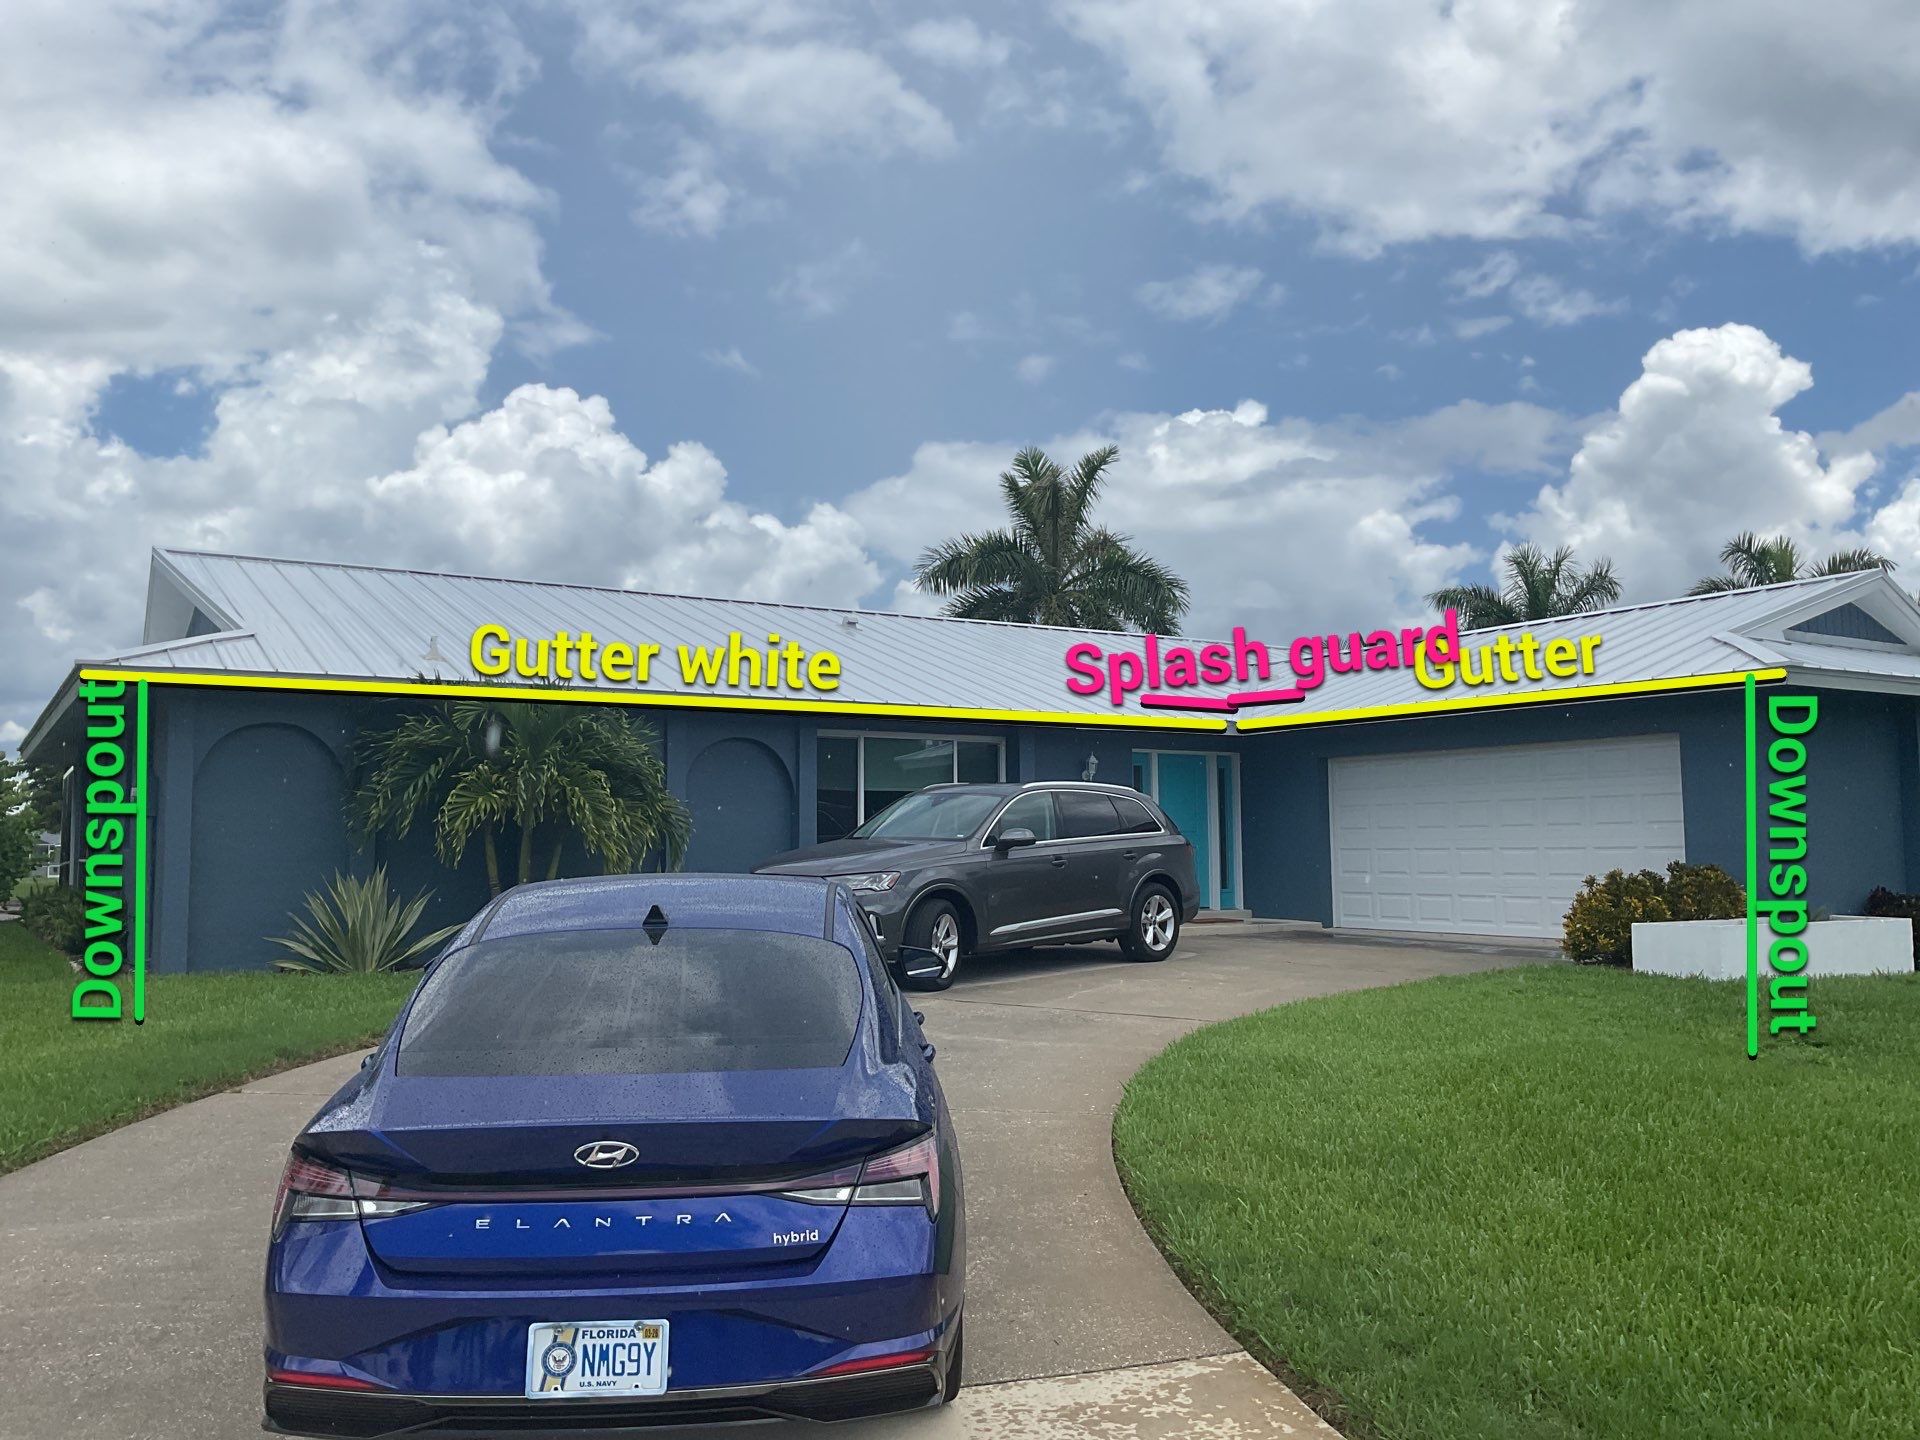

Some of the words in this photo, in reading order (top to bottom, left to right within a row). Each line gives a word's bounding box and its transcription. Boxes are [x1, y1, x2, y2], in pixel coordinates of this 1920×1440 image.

[475, 1212, 732, 1229] ELANTRA
[773, 1230, 819, 1245] hybrid
[581, 1329, 637, 1339] FLORIDA
[581, 1342, 657, 1377] NMG9Y
